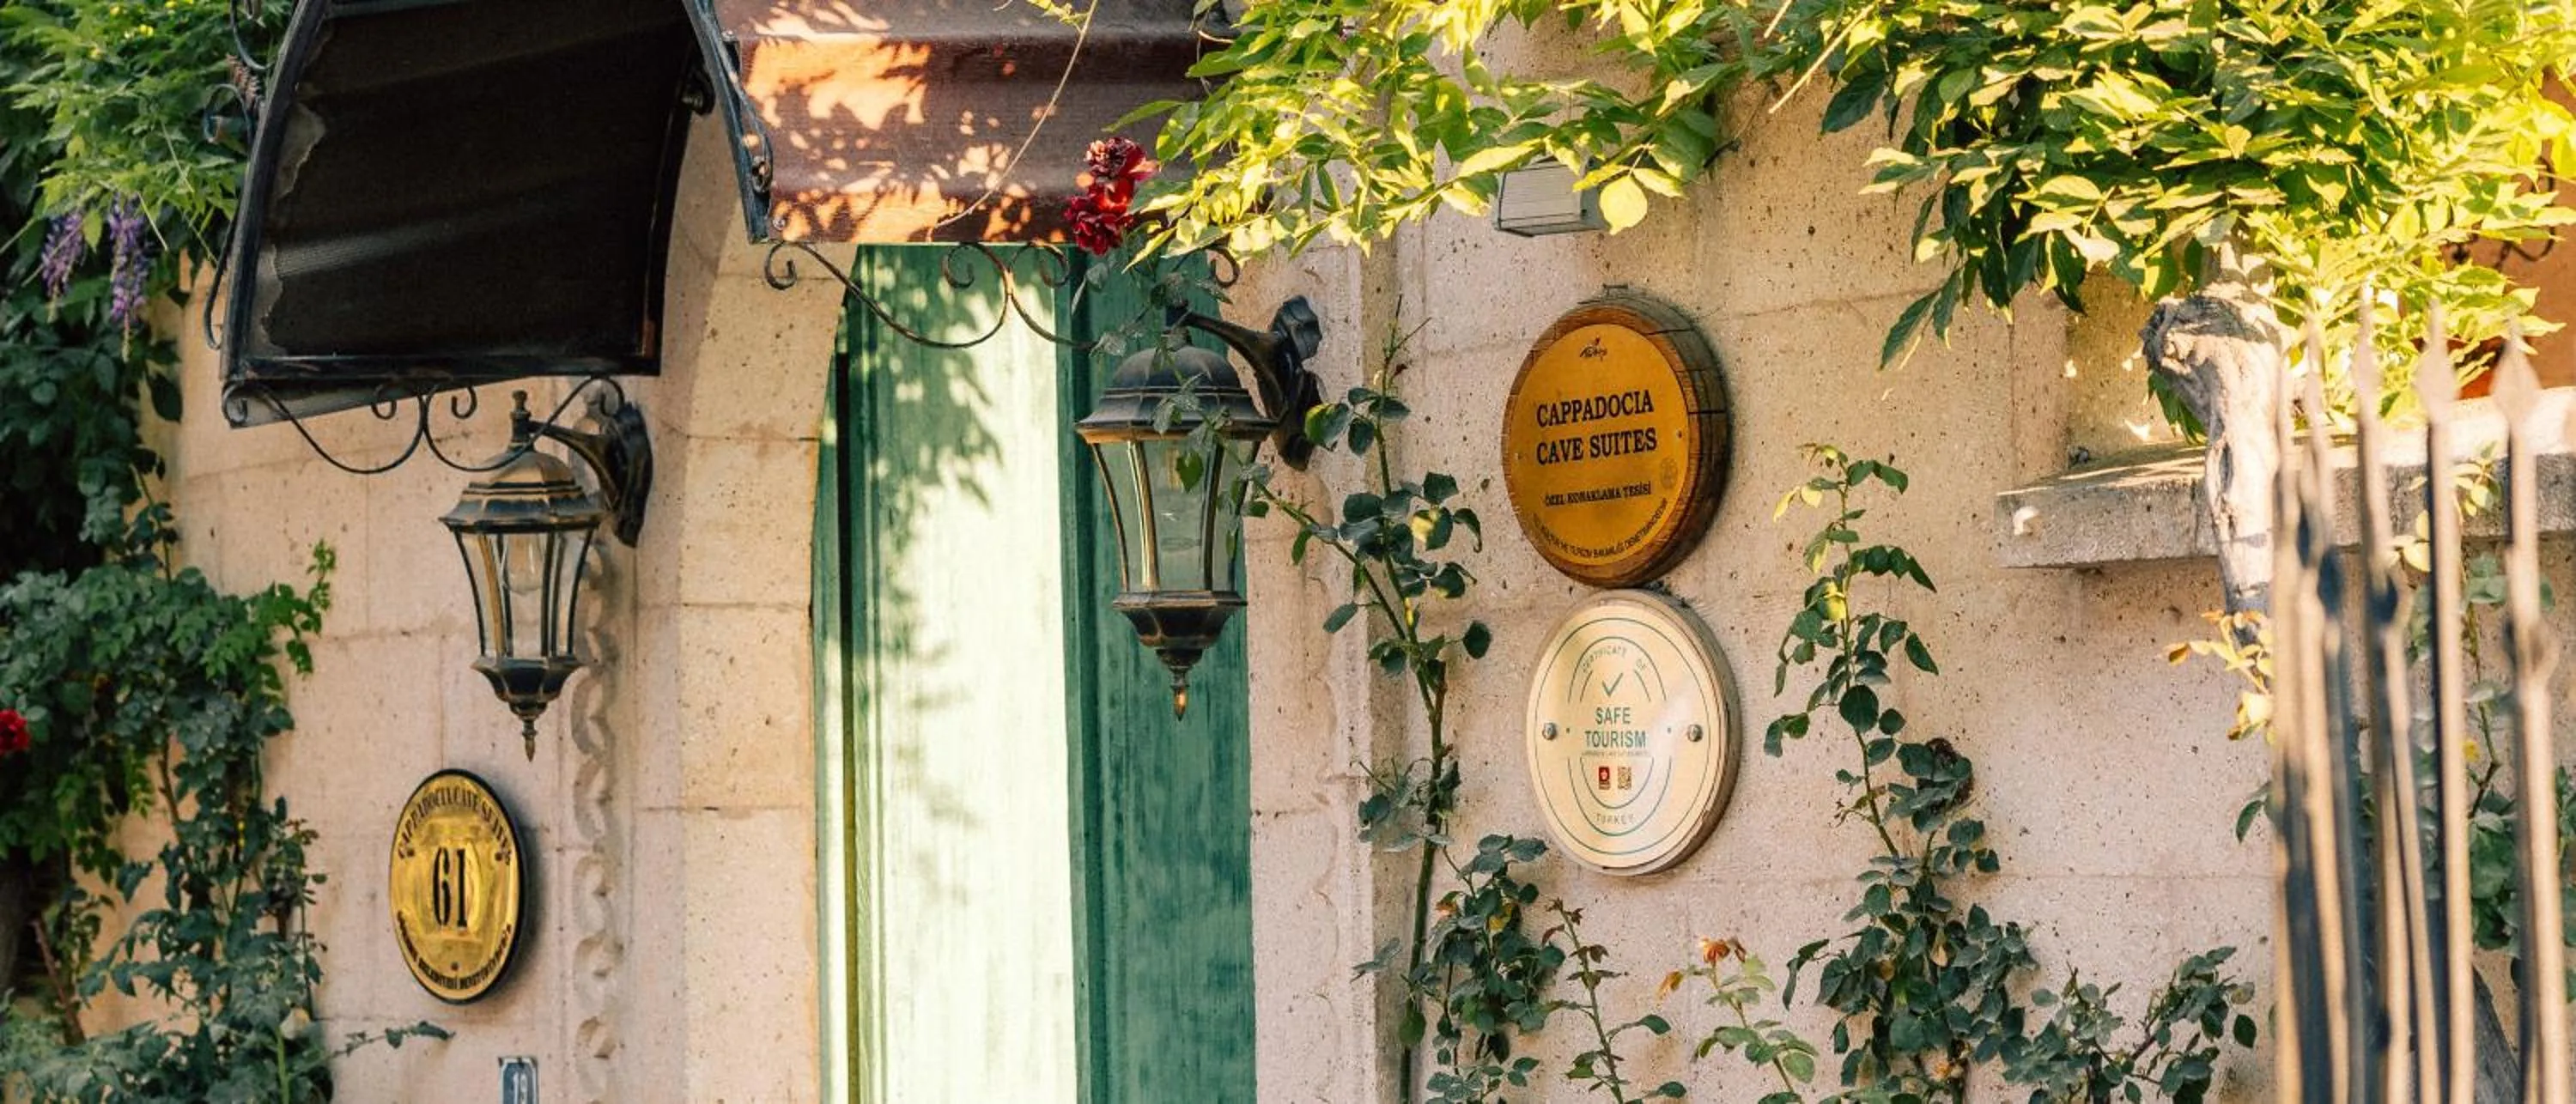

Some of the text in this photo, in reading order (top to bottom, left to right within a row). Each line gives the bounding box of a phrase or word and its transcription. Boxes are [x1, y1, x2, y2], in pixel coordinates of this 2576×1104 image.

[1537, 389, 1655, 428] CAPPADOCIA
[1537, 428, 1657, 465] CAVE SUITES
[1595, 706, 1631, 725] SAFE
[1584, 730, 1646, 749] TOURISM
[433, 847, 467, 928] 61
